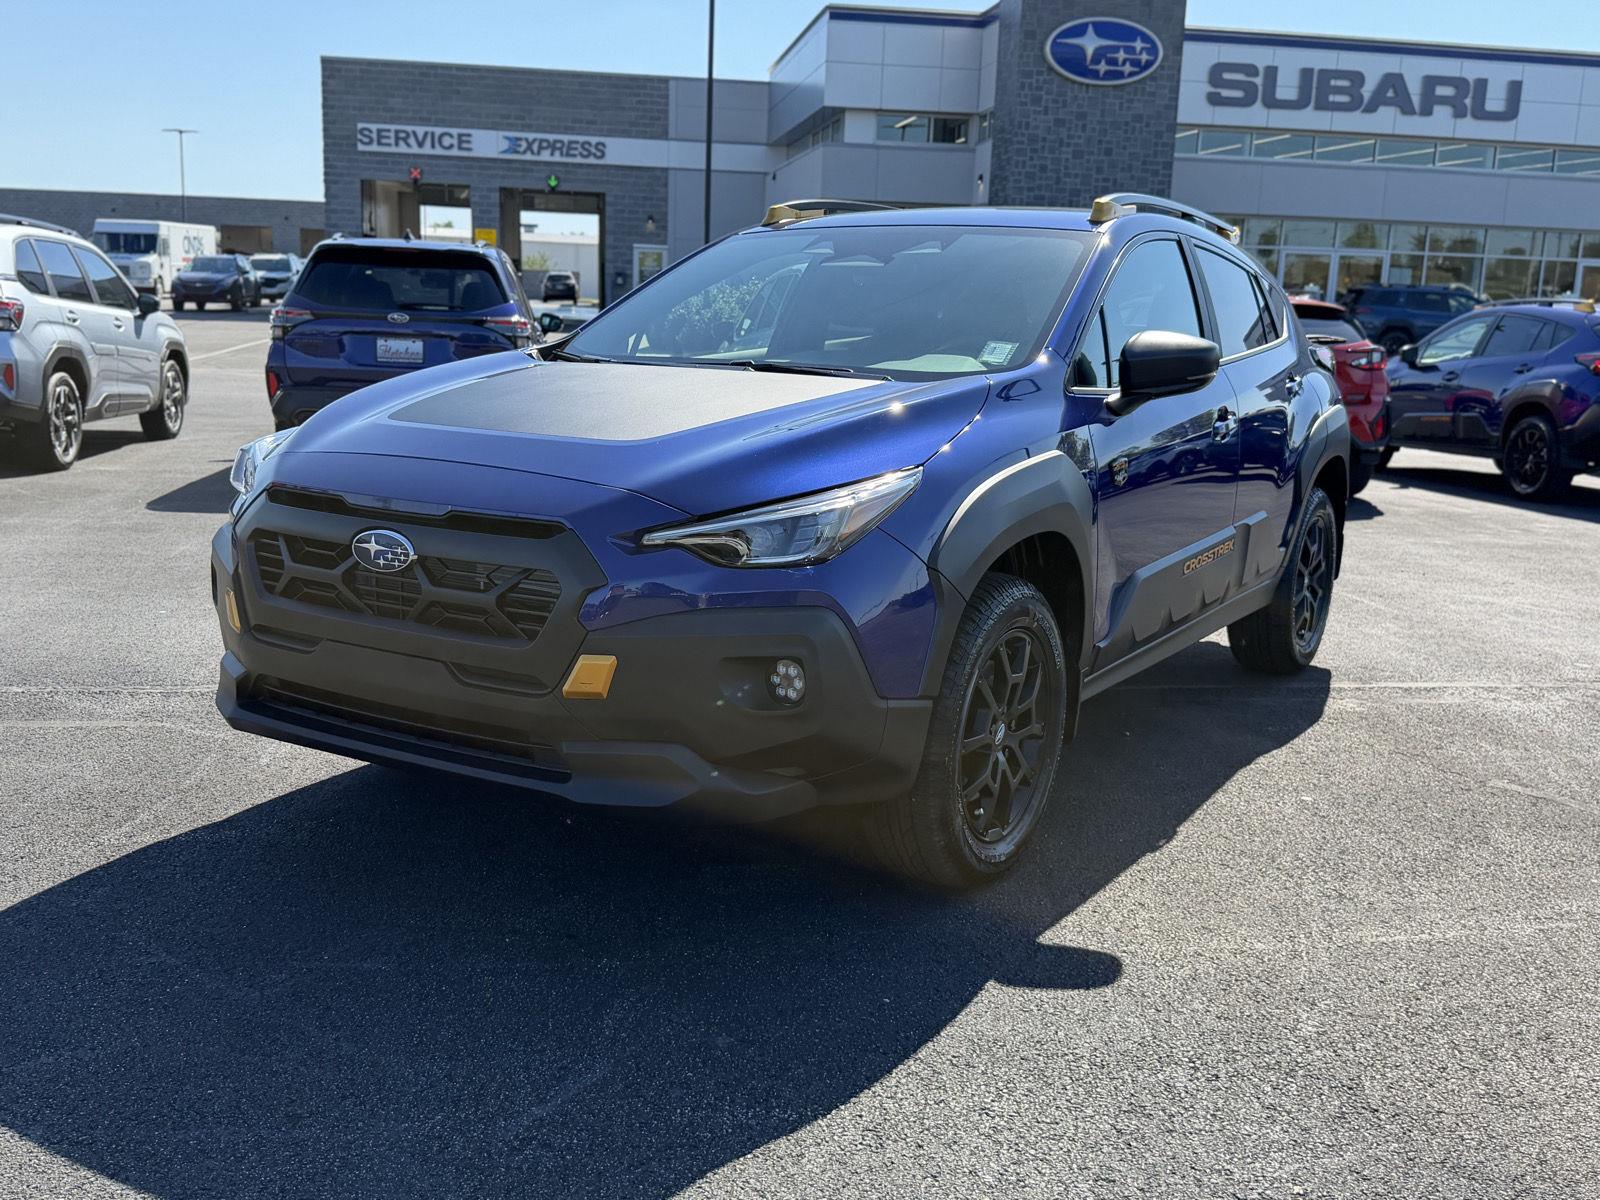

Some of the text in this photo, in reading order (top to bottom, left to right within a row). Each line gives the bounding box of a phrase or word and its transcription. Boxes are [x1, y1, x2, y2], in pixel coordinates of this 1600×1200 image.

[1206, 62, 1523, 121] SUBARU
[357, 127, 473, 151] SERVICE
[500, 134, 607, 160] EXPRESS
[1183, 540, 1235, 574] CROSSTREK
